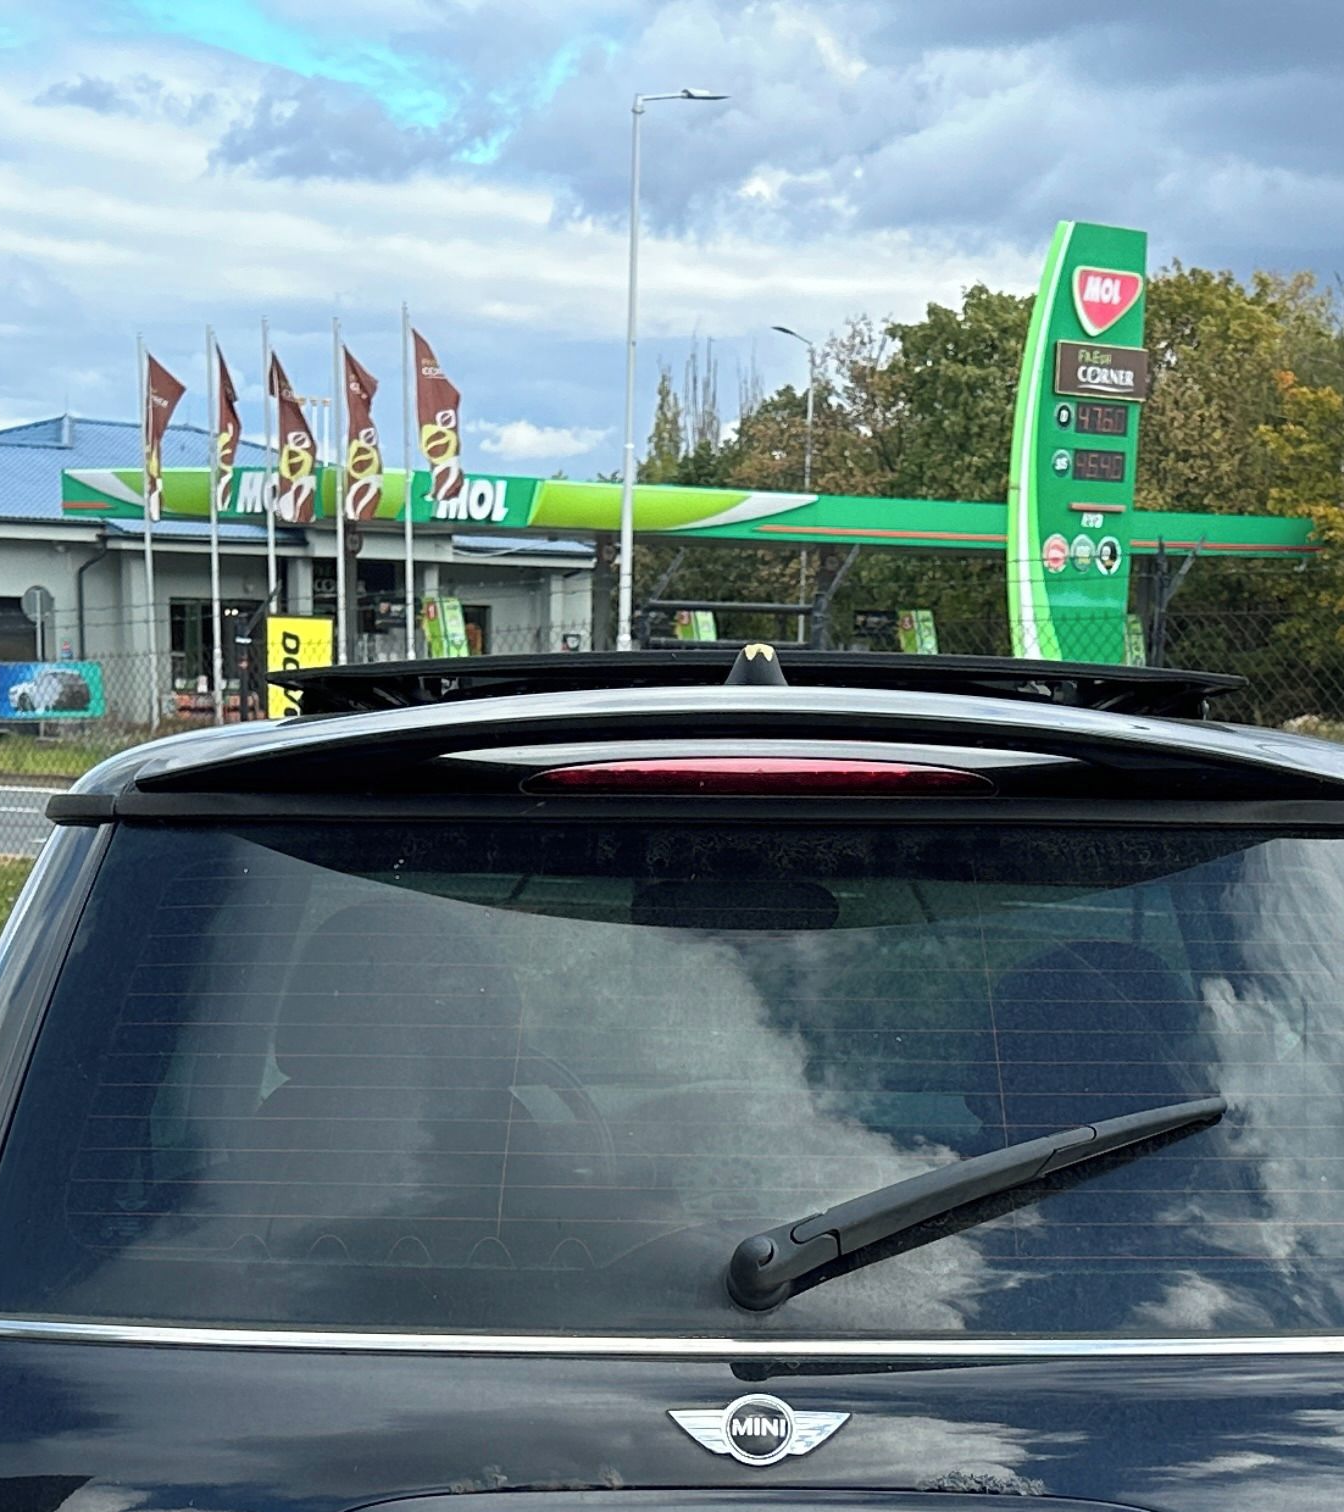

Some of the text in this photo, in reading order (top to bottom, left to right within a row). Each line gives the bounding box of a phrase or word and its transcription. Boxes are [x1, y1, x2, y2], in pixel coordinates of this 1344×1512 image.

[1083, 276, 1121, 304] MOL
[1077, 366, 1134, 386] CORNER
[732, 1418, 788, 1437] MINI
